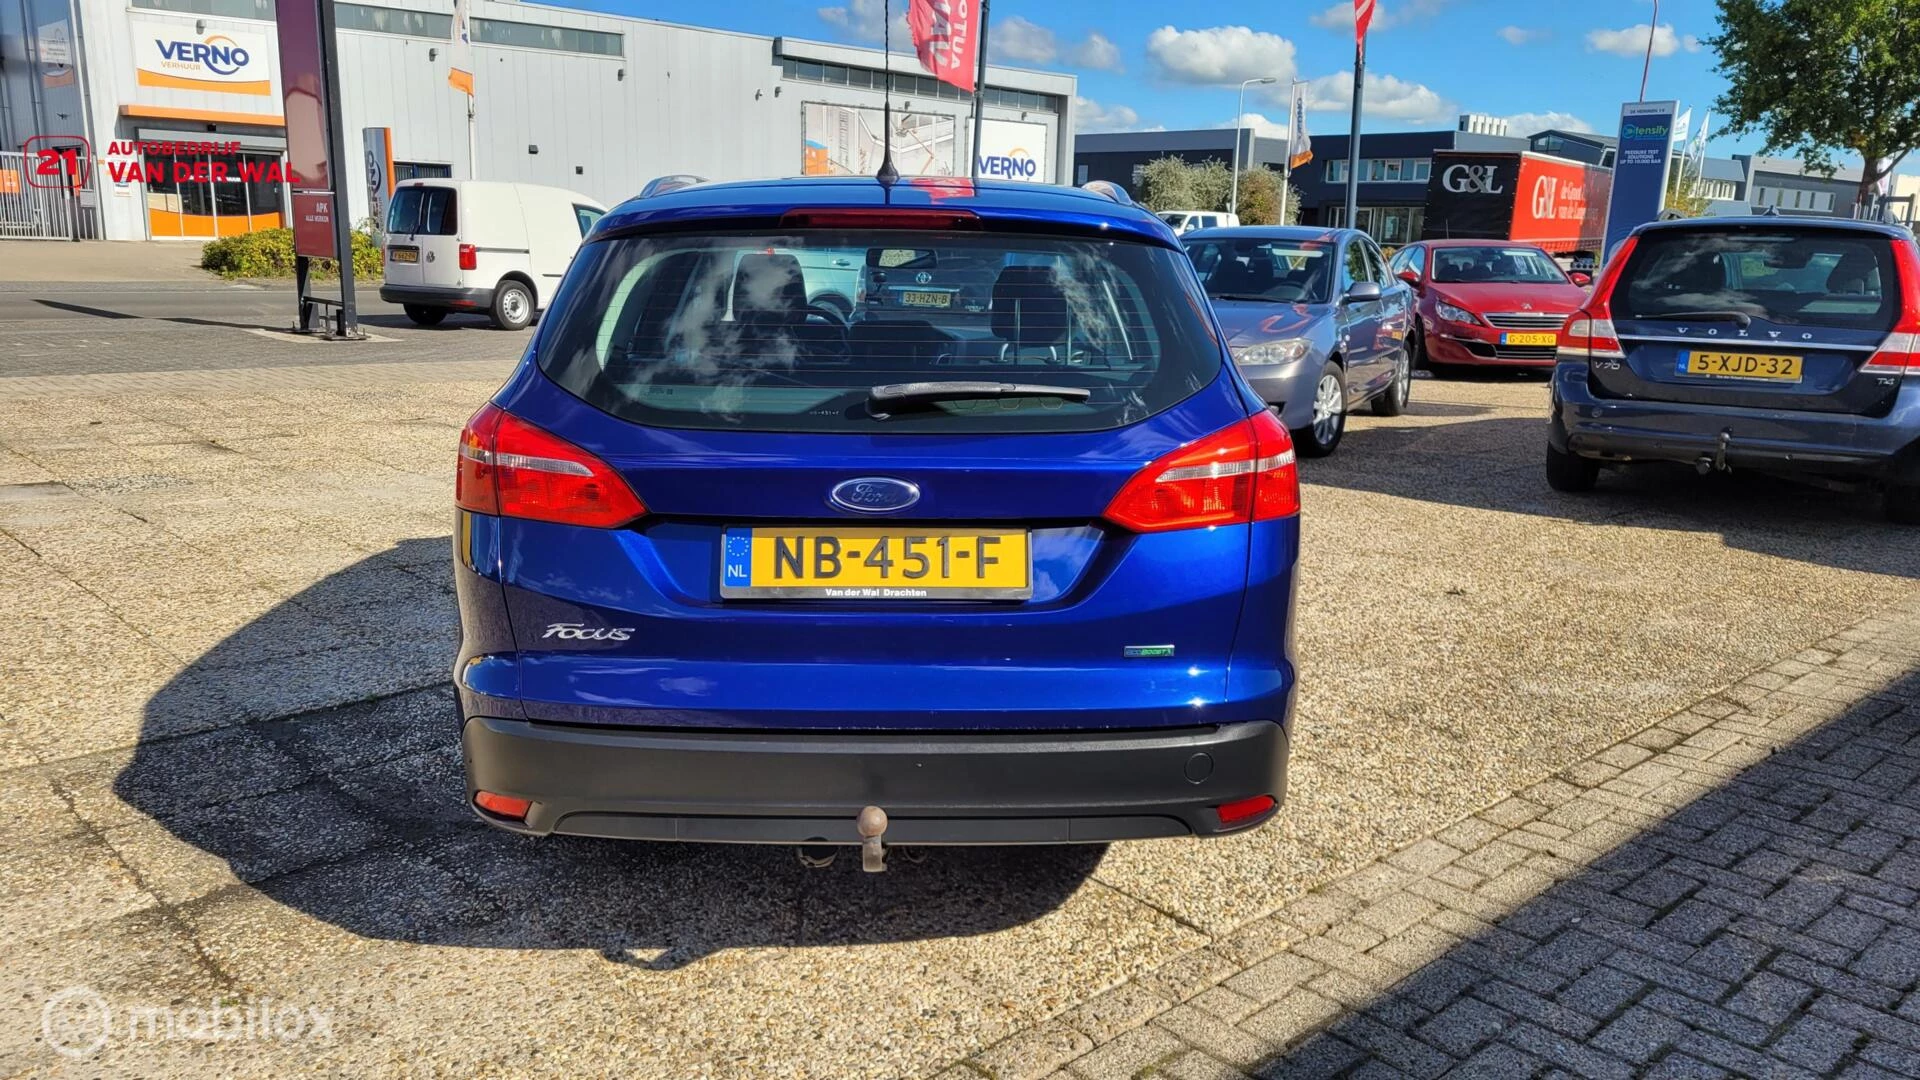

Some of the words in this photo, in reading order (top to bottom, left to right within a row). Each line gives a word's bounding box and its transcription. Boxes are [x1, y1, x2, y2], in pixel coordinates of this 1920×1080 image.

[155, 39, 249, 75] VERNO
[161, 61, 201, 70] VERHUUR
[979, 155, 1036, 179] VERNO
[1442, 164, 1503, 194] G&L
[316, 202, 328, 213] APK
[1509, 334, 1554, 344] G-205-XG
[1697, 354, 1793, 376] 5-XJD-32
[727, 564, 747, 578] NL
[773, 535, 1001, 579] NB-451-F
[825, 588, 843, 597] Van
[845, 588, 861, 597] der
[862, 588, 880, 597] Wal
[883, 588, 927, 597] Drachten
